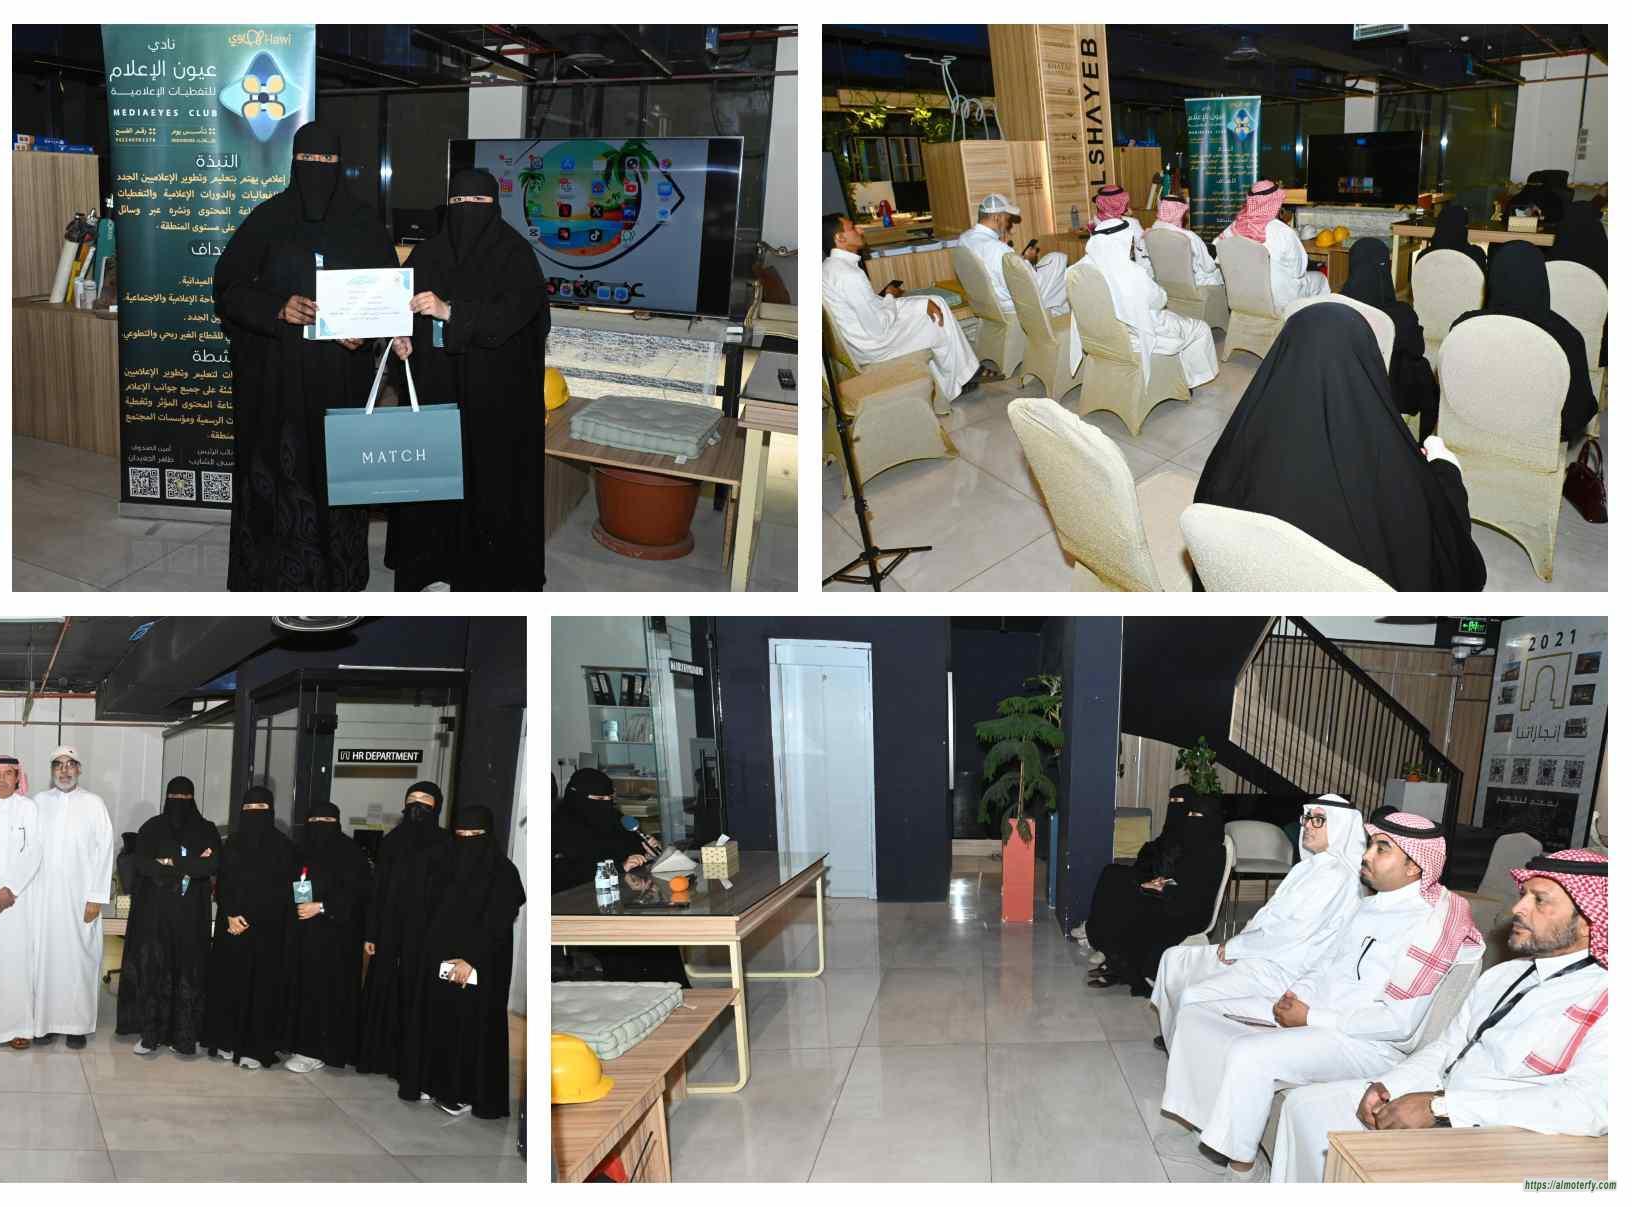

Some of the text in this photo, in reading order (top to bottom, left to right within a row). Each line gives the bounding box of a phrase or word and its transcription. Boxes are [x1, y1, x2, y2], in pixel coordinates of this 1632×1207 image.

[147, 37, 176, 52] نادي
[109, 59, 217, 81] عيون الإعلام
[113, 108, 218, 117] MEDIAEYES CLUB
[1080, 38, 1107, 203] LSHAYEB
[195, 153, 240, 169] النبذة
[117, 172, 138, 182] الجدد
[141, 173, 178, 184] الإعلاميين
[260, 175, 286, 186] إعلامي
[118, 189, 157, 200] والتغطيات
[163, 189, 194, 200] الإعلامية
[200, 190, 236, 200] والدورات
[118, 204, 140, 216] وسائل
[149, 208, 161, 216] عبر
[169, 207, 191, 217] ونشره
[198, 206, 231, 216] المحتوى
[192, 223, 220, 232] مستوى
[222, 224, 236, 233] على
[168, 293, 198, 305] الإعلامية
[123, 367, 159, 378] الإعلاميين
[125, 382, 150, 394] الإعلام
[125, 412, 156, 424] المجتمع
[361, 448, 427, 464] MATCH
[1528, 629, 1577, 652] 2021
[1515, 721, 1561, 743] إنجازاتنا
[352, 751, 419, 761] HR DEPARTMENT
